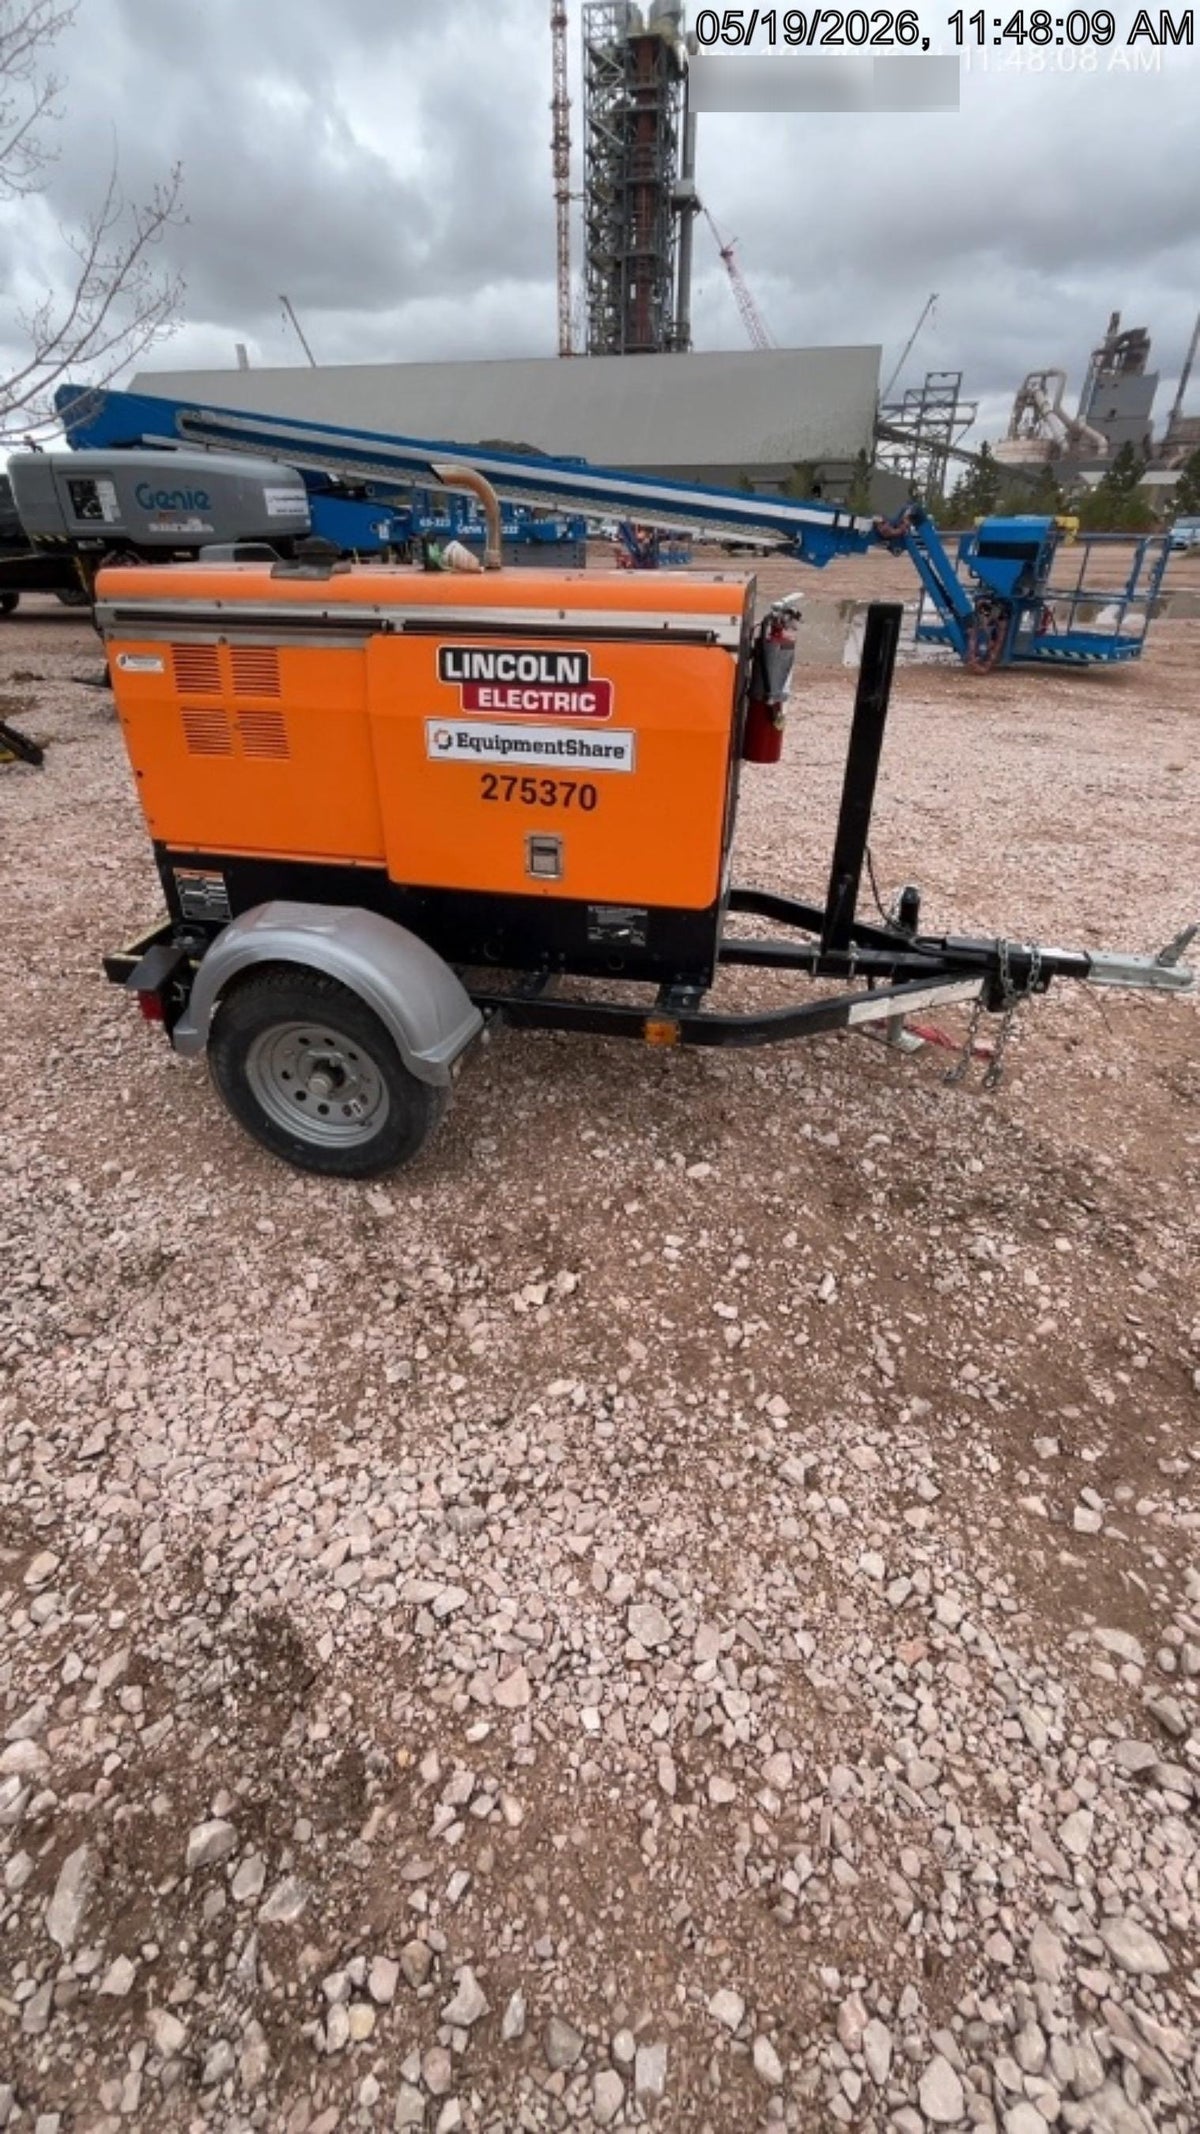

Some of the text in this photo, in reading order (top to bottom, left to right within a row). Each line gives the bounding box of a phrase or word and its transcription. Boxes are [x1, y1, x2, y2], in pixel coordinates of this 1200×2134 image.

[135, 484, 211, 511] Genie
[445, 652, 581, 684] LINCOLN
[478, 687, 596, 713] ELECTRIC
[456, 732, 626, 759] EquipmentShare
[480, 773, 598, 811] 275370
